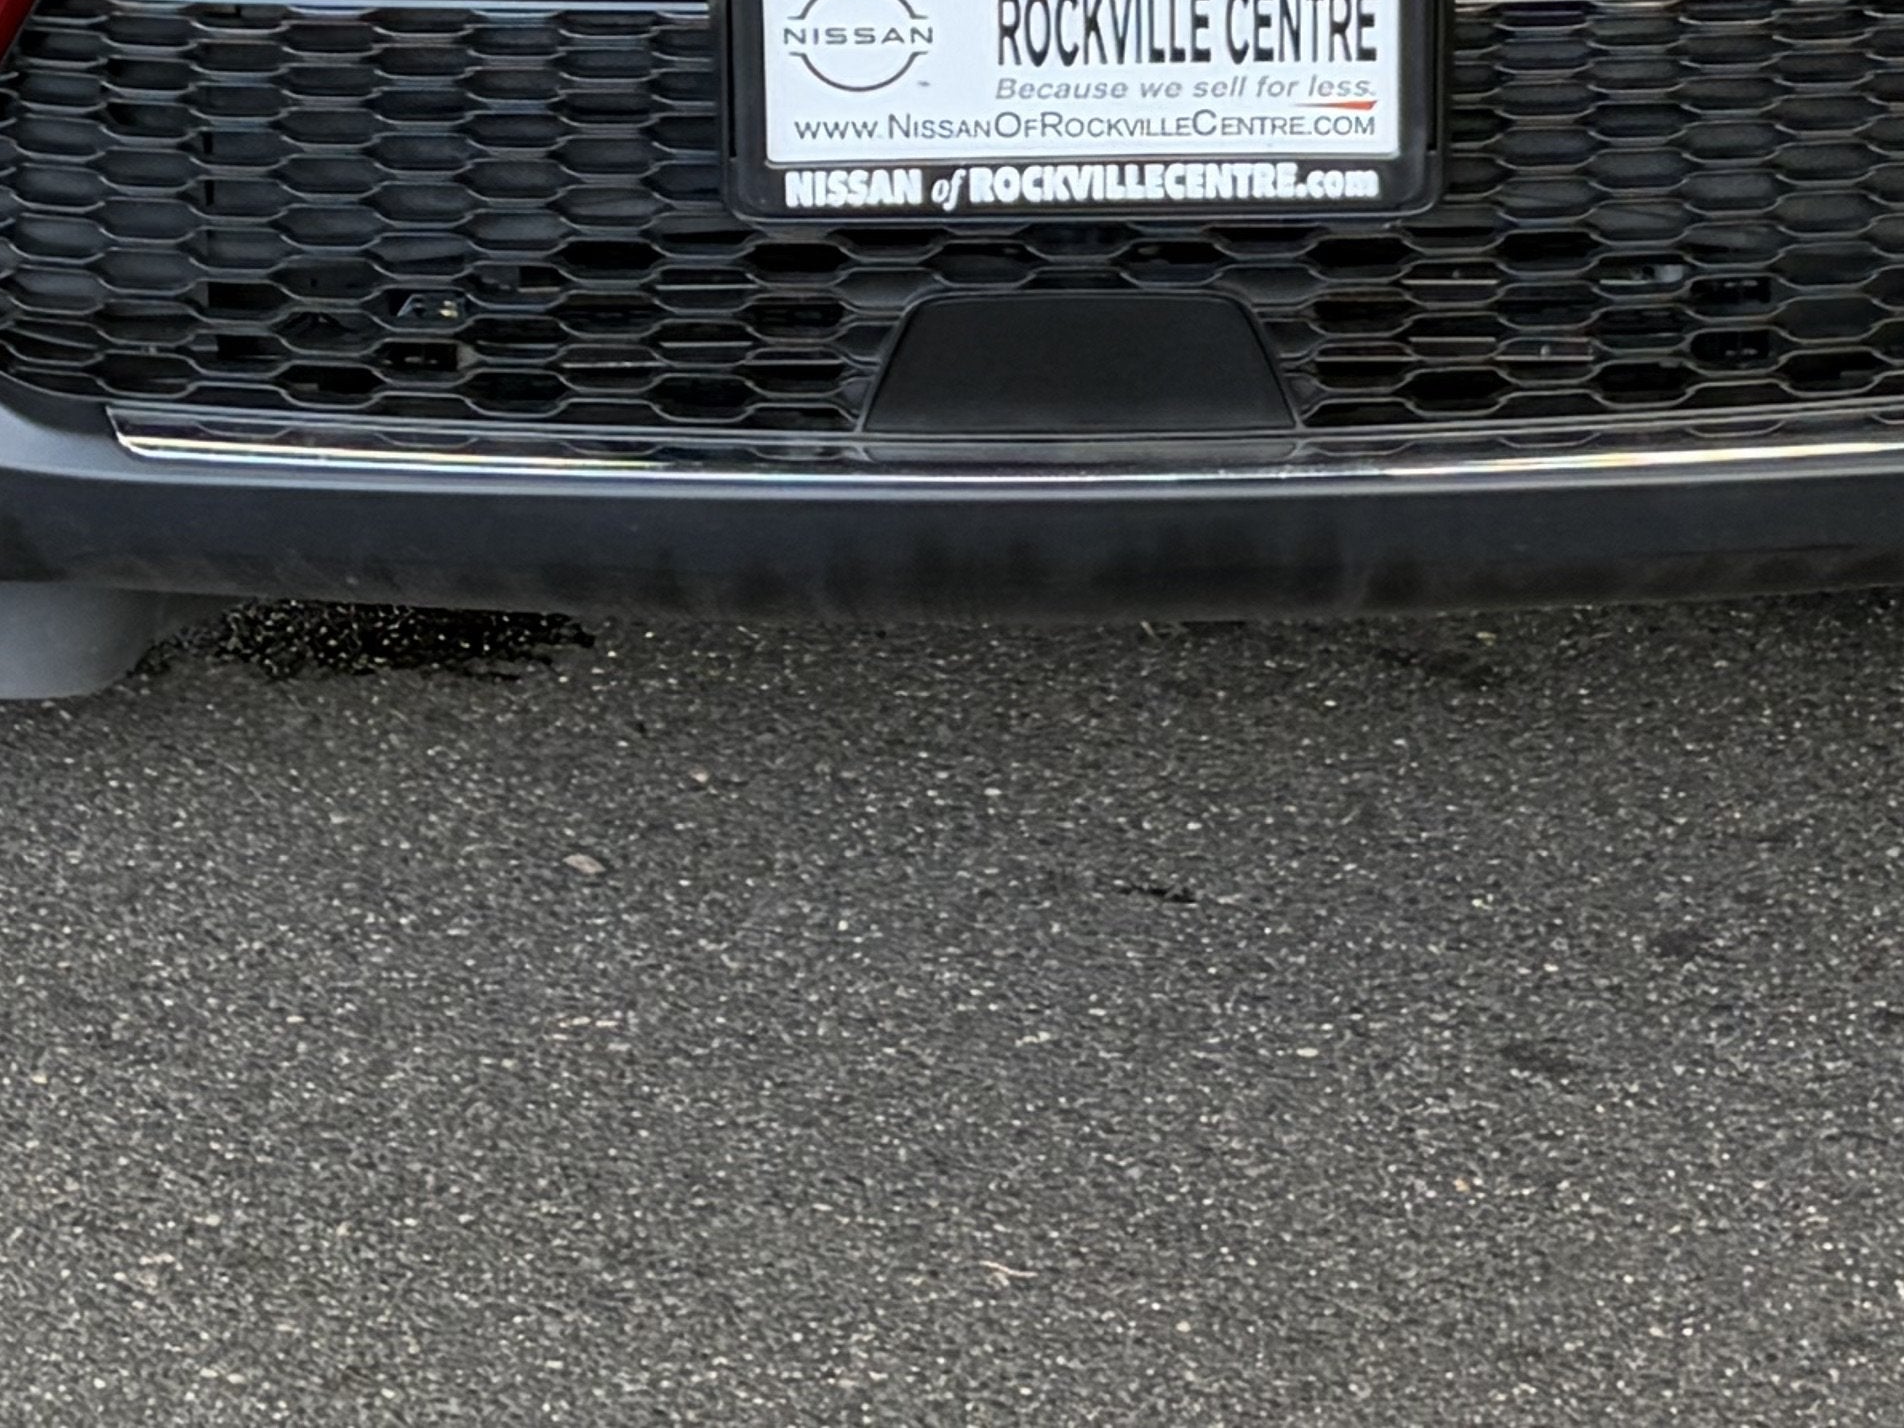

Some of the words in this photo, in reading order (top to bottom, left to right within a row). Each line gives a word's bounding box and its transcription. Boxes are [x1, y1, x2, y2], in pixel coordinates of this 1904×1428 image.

[783, 26, 934, 45] NISSAN
[995, 77, 1128, 100] Because
[1140, 81, 1184, 99] we
[1193, 75, 1248, 99] sell
[1256, 75, 1300, 98] for
[1308, 74, 1377, 97] less.
[785, 167, 924, 209] NISSAN
[932, 168, 967, 212] of
